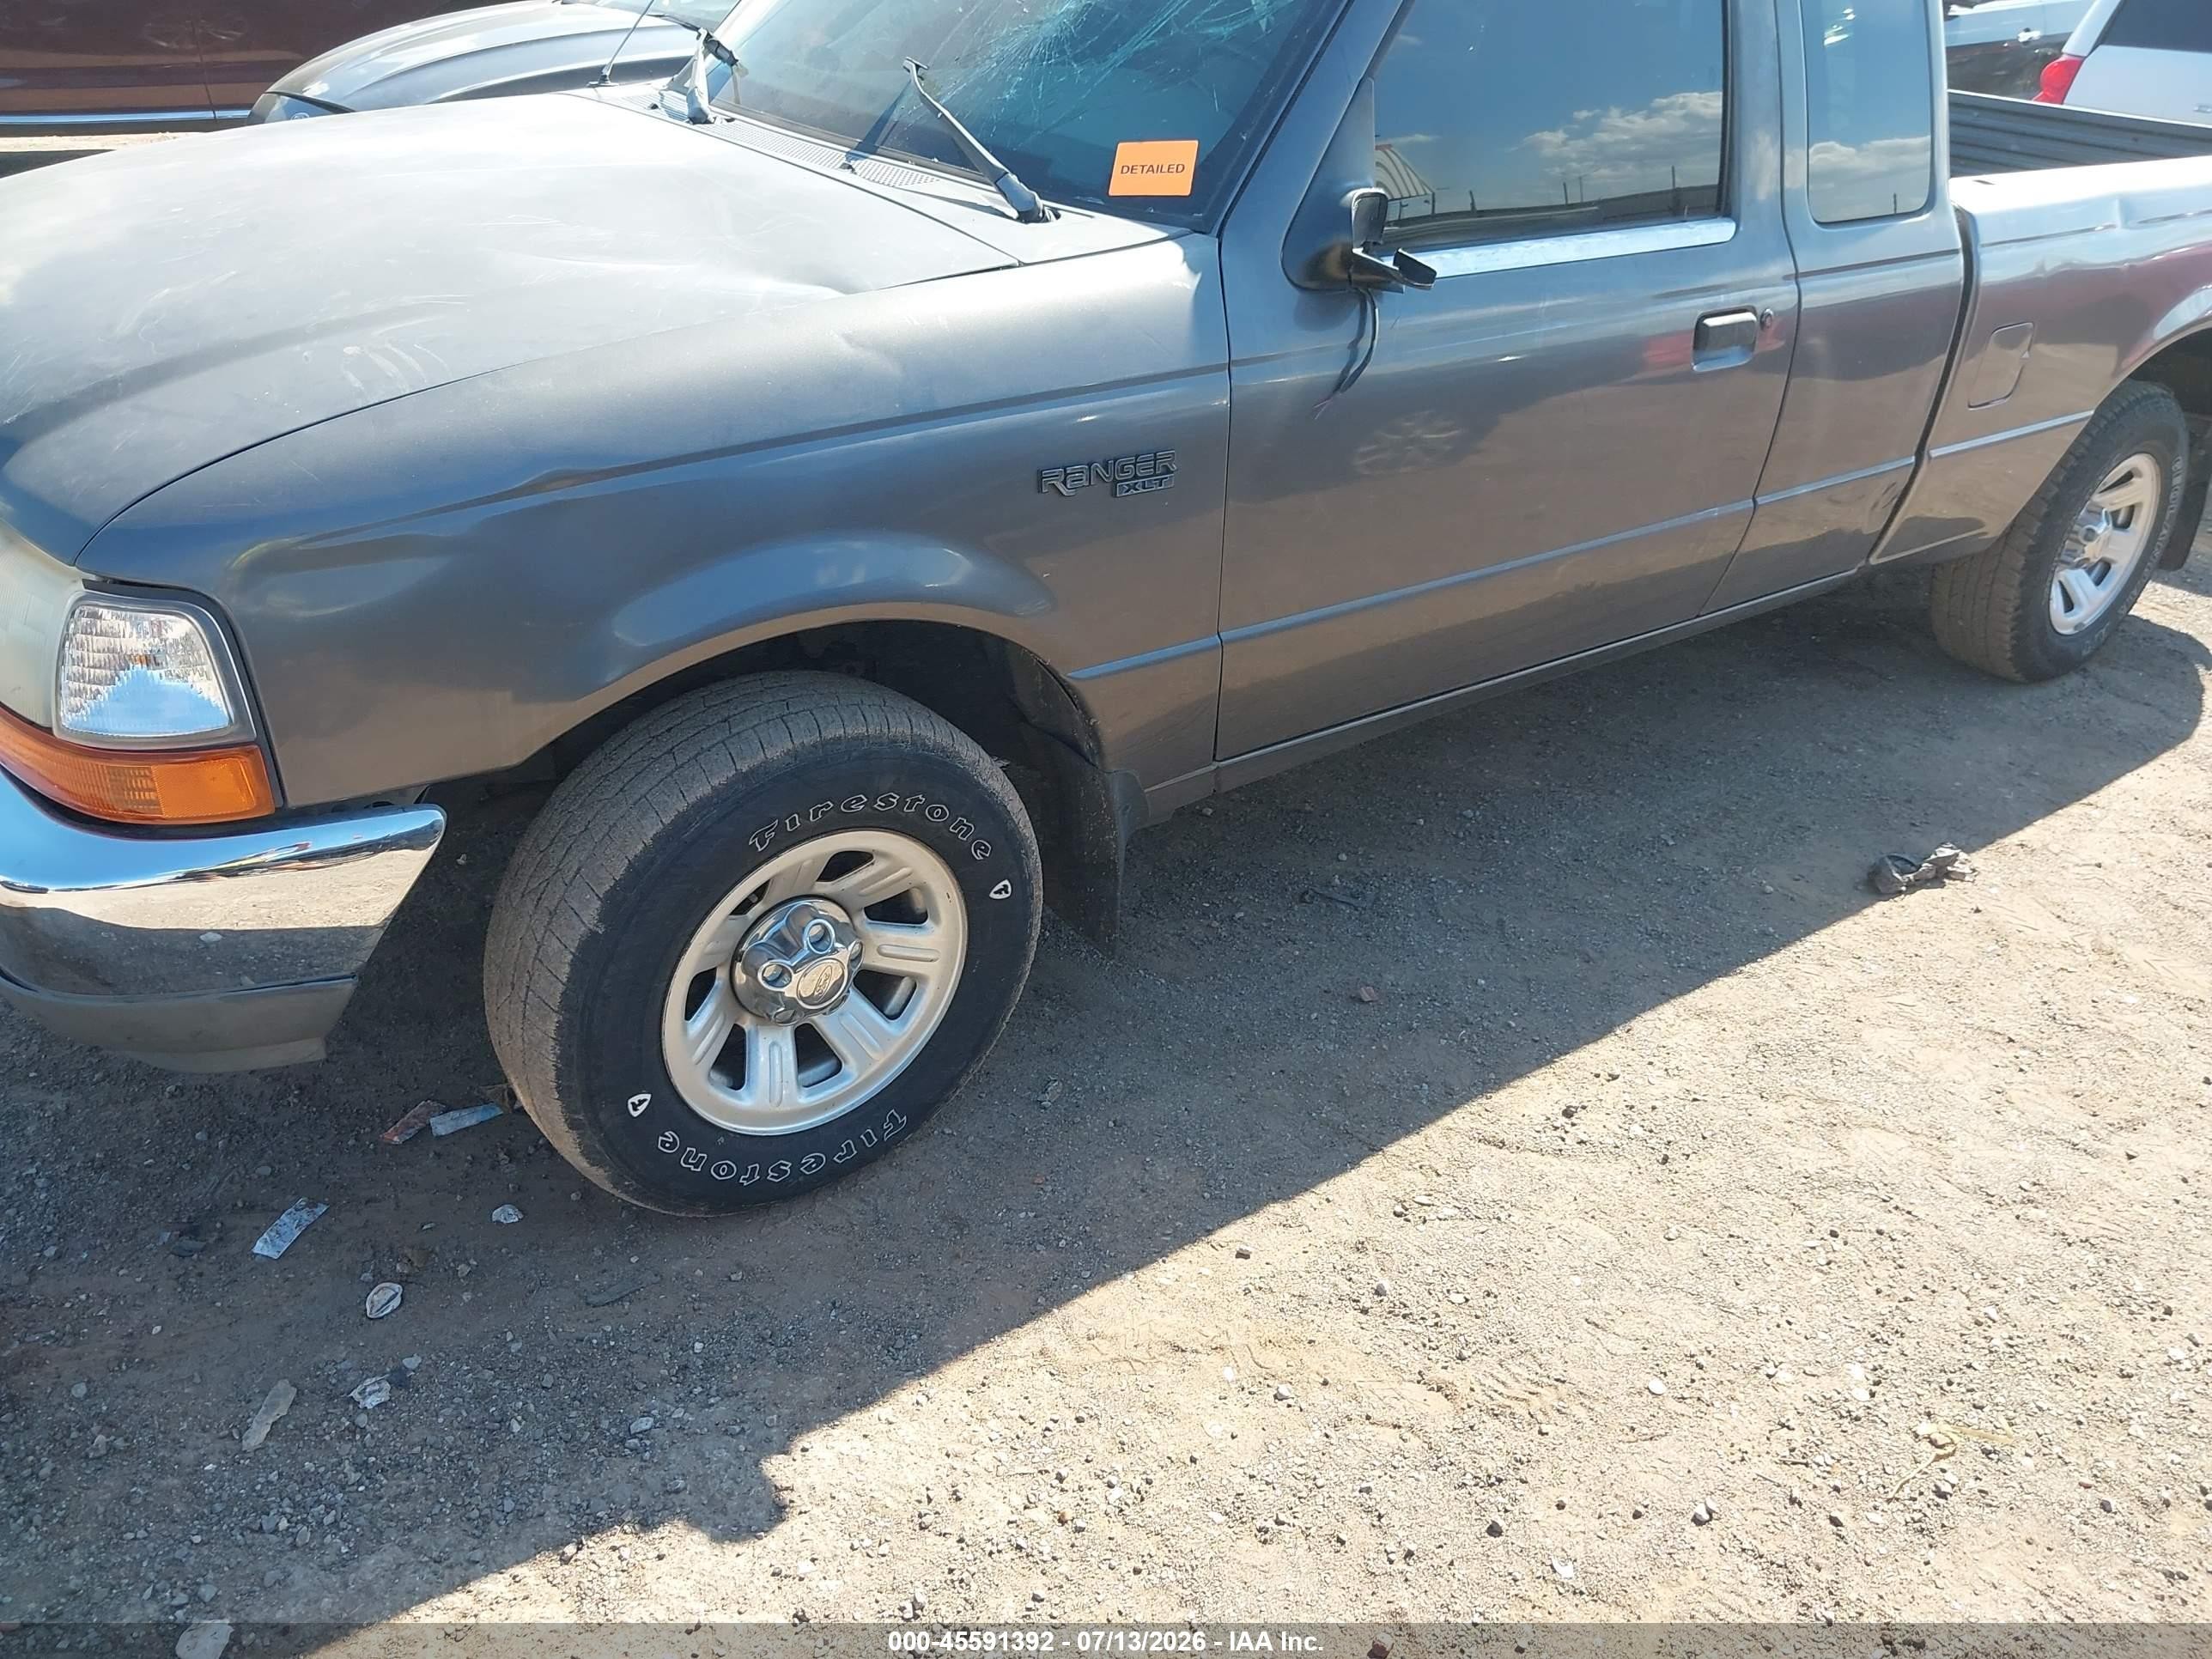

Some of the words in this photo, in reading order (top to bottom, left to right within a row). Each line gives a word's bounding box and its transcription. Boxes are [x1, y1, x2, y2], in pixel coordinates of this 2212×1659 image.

[1120, 163, 1186, 175] DETAILED
[1120, 476, 1171, 495] XLT
[748, 791, 993, 861] Firestone
[657, 1109, 908, 1187] Firestone
